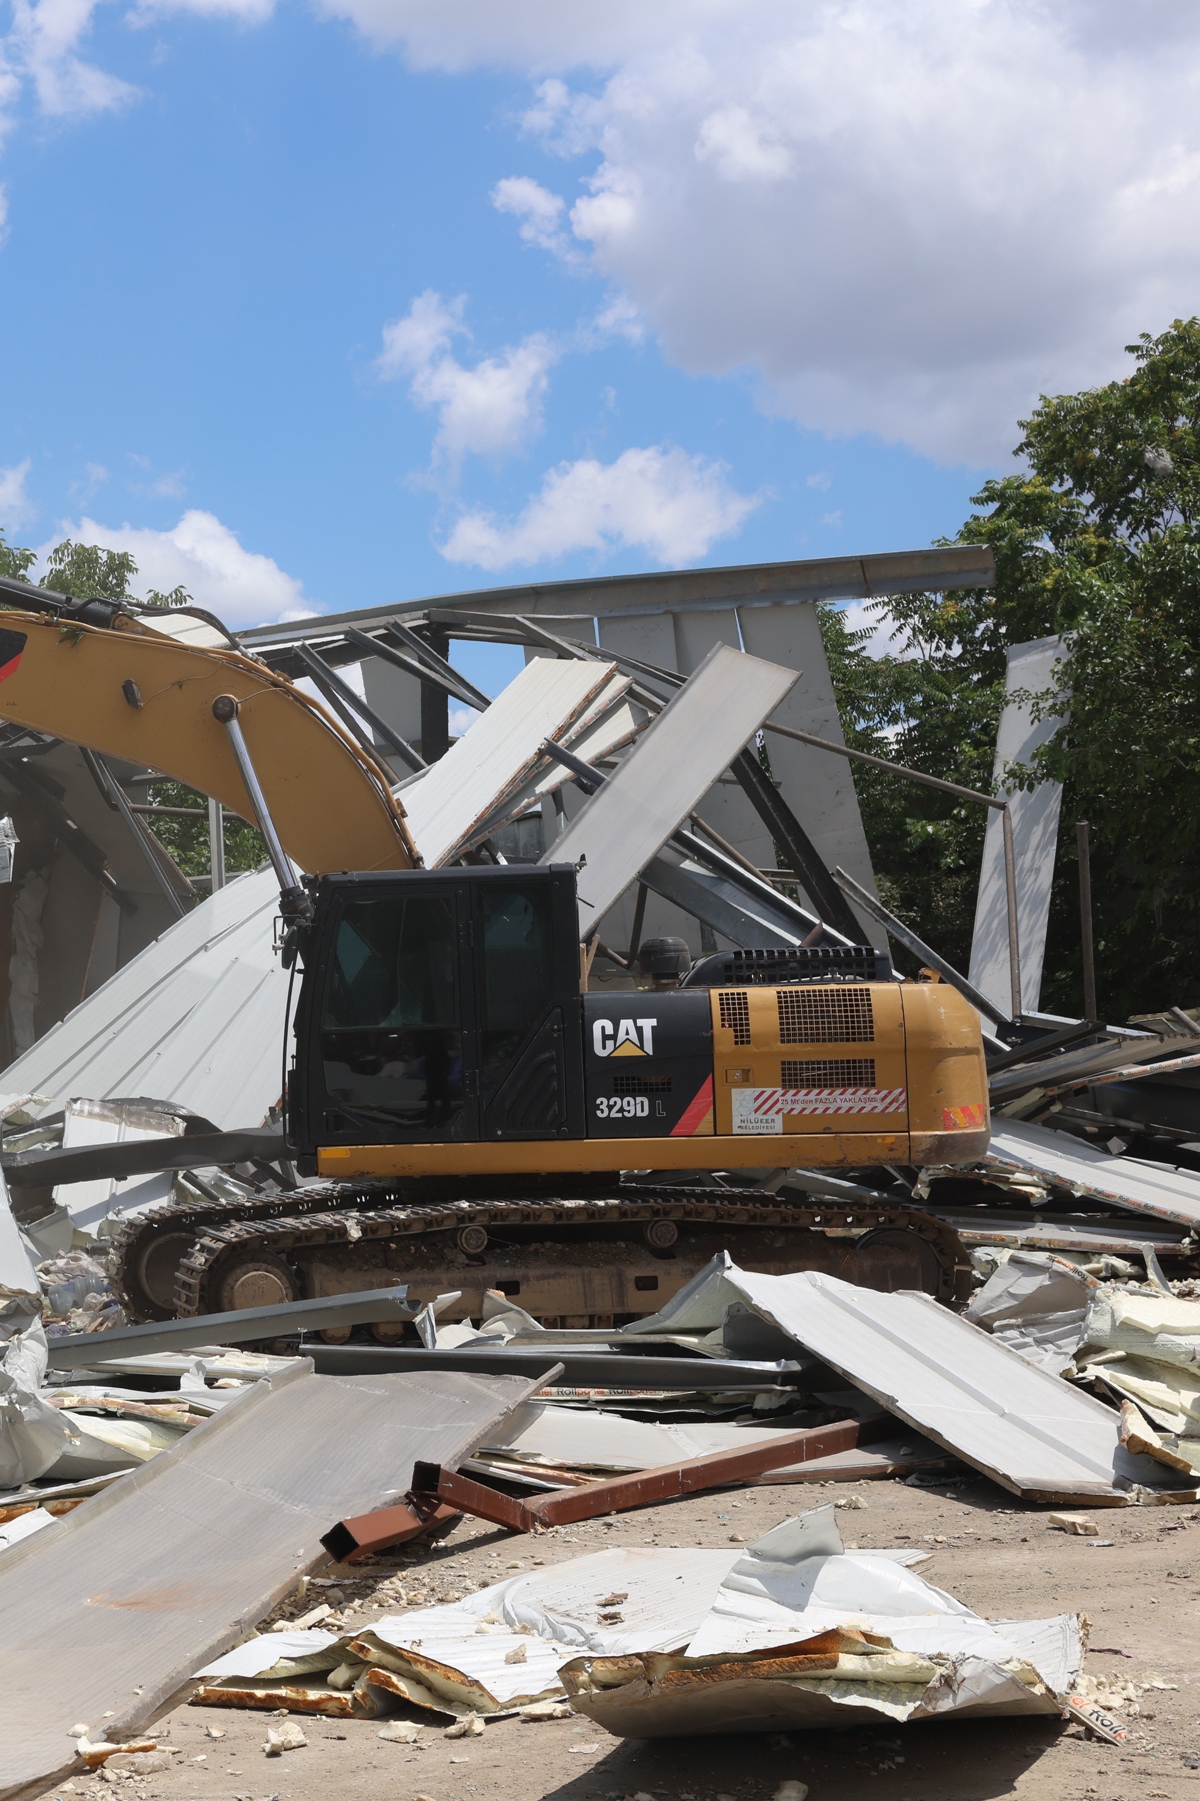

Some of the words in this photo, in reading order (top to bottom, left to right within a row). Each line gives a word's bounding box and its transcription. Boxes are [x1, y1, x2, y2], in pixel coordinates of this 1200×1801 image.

[592, 1018, 658, 1057] CAT
[595, 1096, 650, 1118] 329D
[655, 1100, 667, 1117] L
[814, 1097, 838, 1105] FAZLA
[740, 1116, 776, 1125] NİLÜFER
